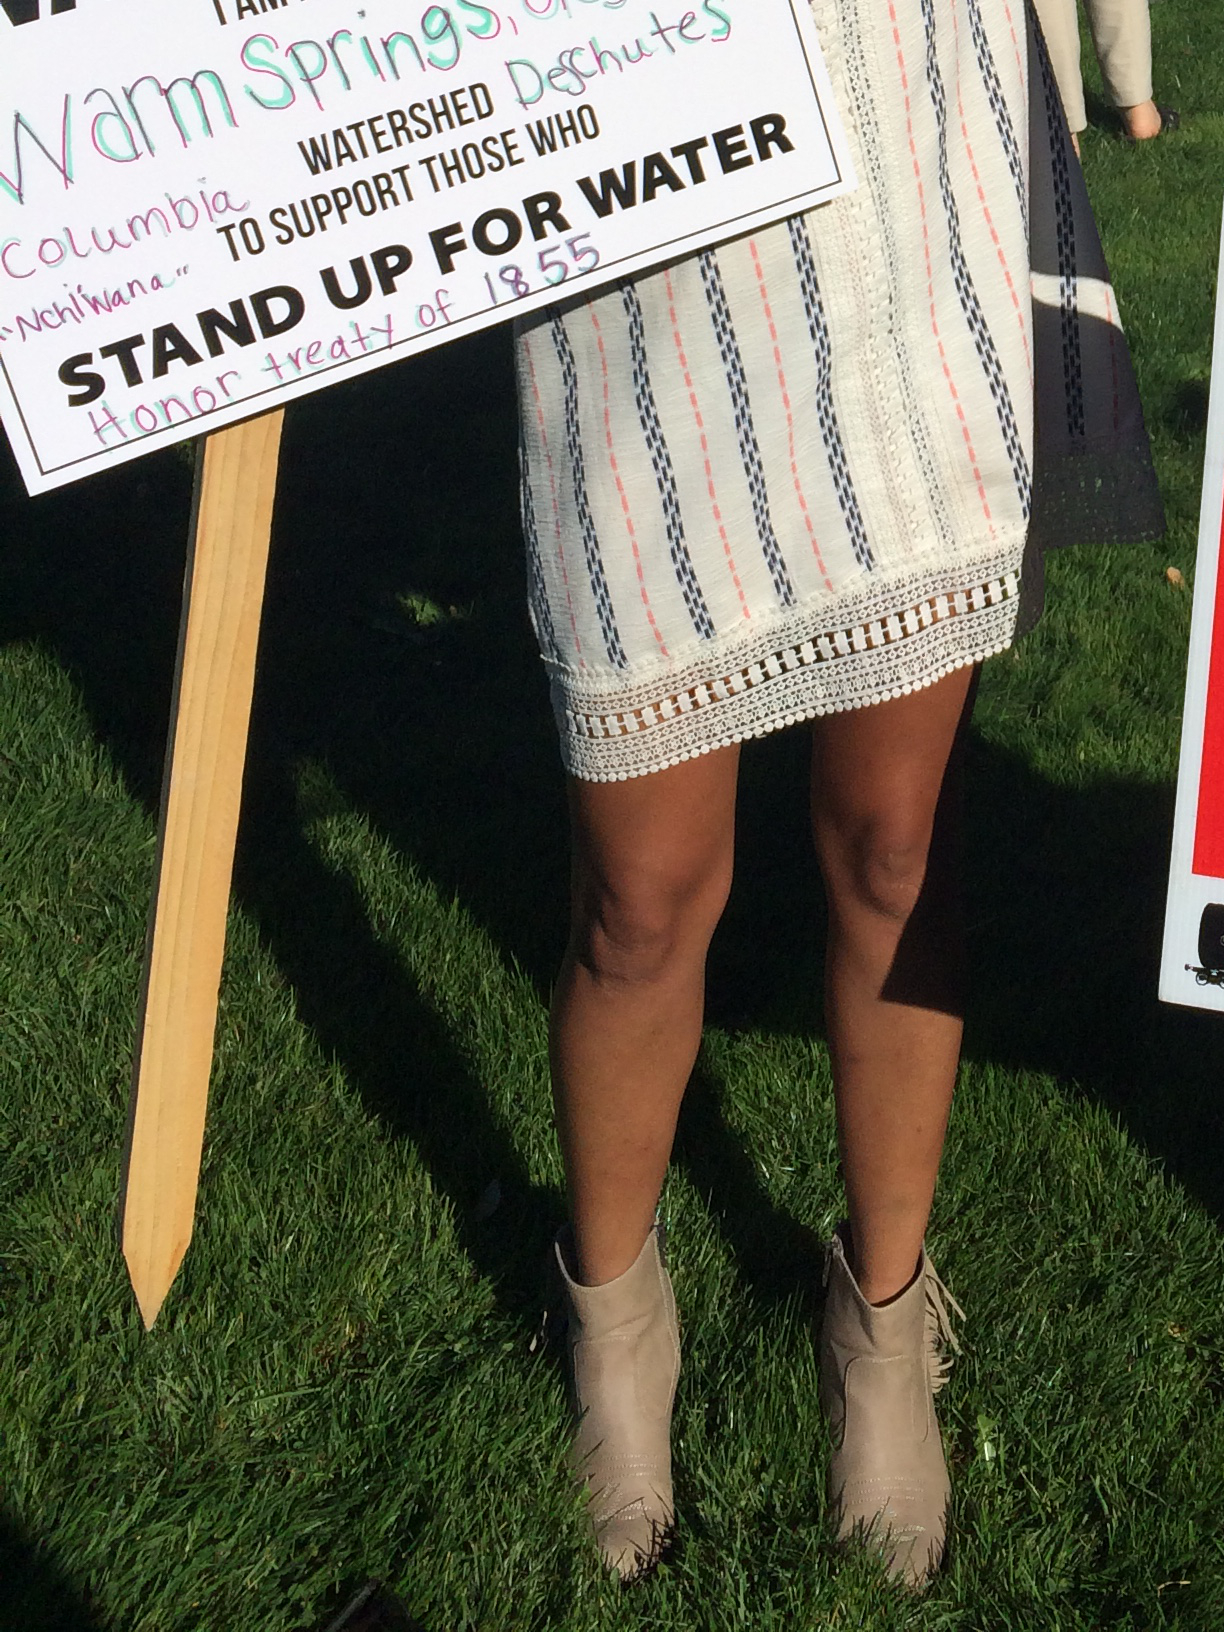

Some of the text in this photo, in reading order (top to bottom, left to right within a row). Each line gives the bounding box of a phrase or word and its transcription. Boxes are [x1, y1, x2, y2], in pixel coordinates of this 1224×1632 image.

[216, 104, 601, 262] TO SUPPORT THOSE WHO
[297, 81, 495, 176] WATERSHED
[58, 113, 796, 408] STAND UP FOR WATER
[87, 232, 601, 448] Honor treaty of 1855
